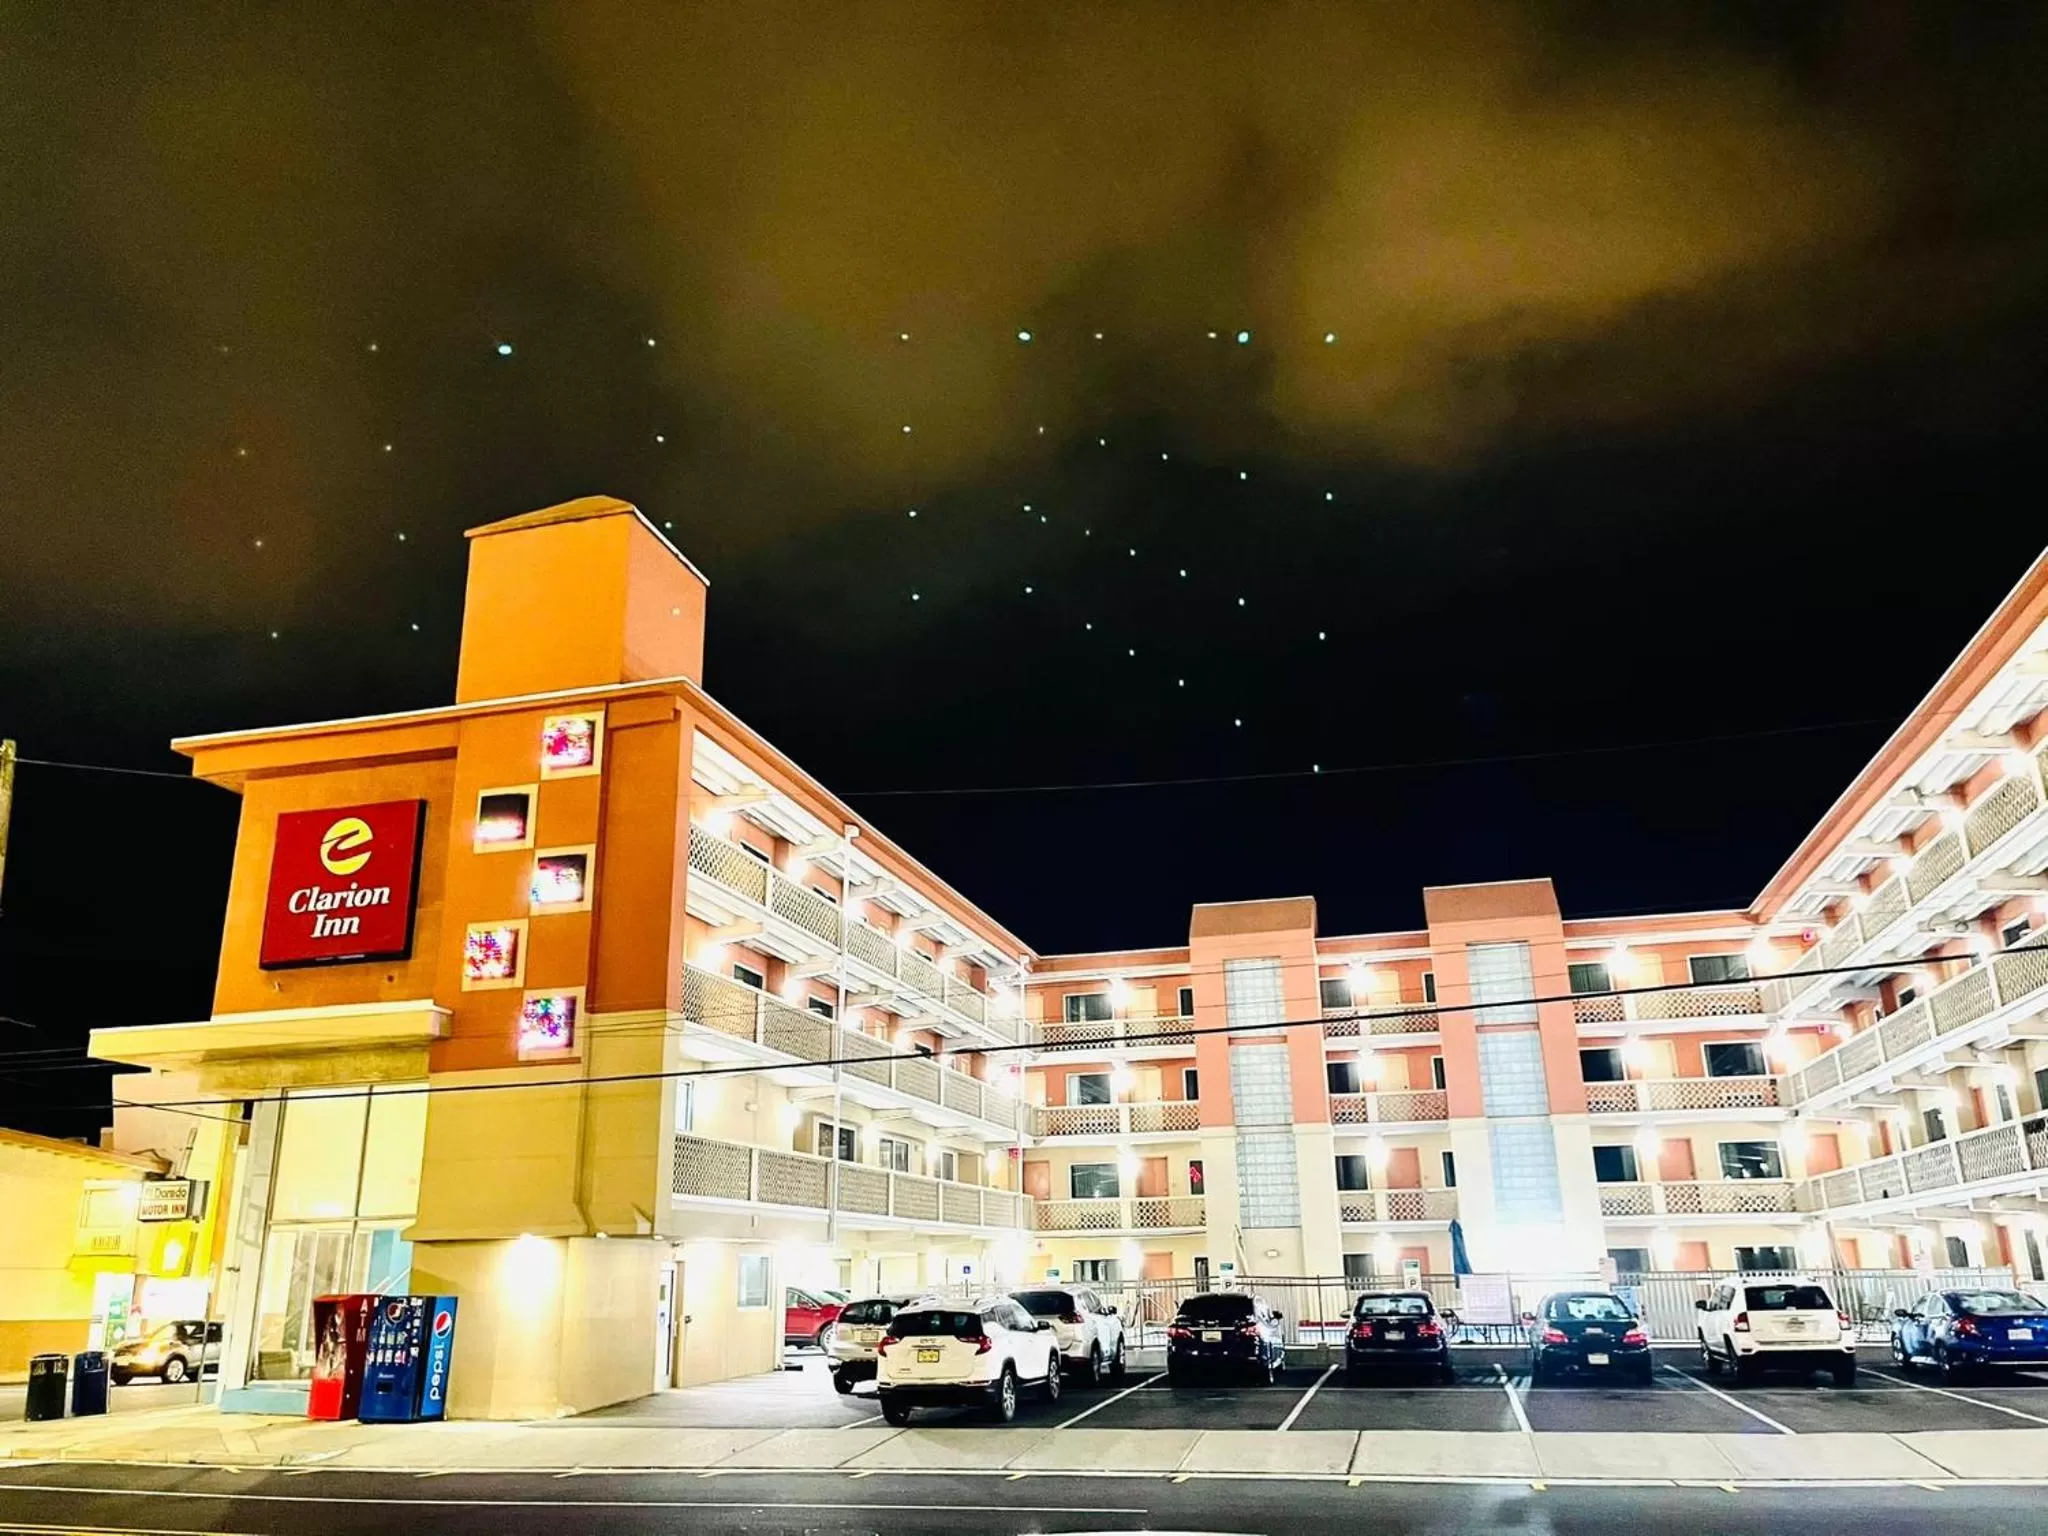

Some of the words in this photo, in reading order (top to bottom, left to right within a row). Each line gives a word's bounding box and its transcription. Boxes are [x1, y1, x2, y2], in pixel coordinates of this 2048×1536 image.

[288, 882, 390, 914] Clarion
[310, 914, 360, 938] Inn
[154, 1187, 187, 1198] Dorado
[141, 1203, 168, 1216] MOTOR
[171, 1203, 186, 1215] INN
[429, 1344, 444, 1400] pepsi
